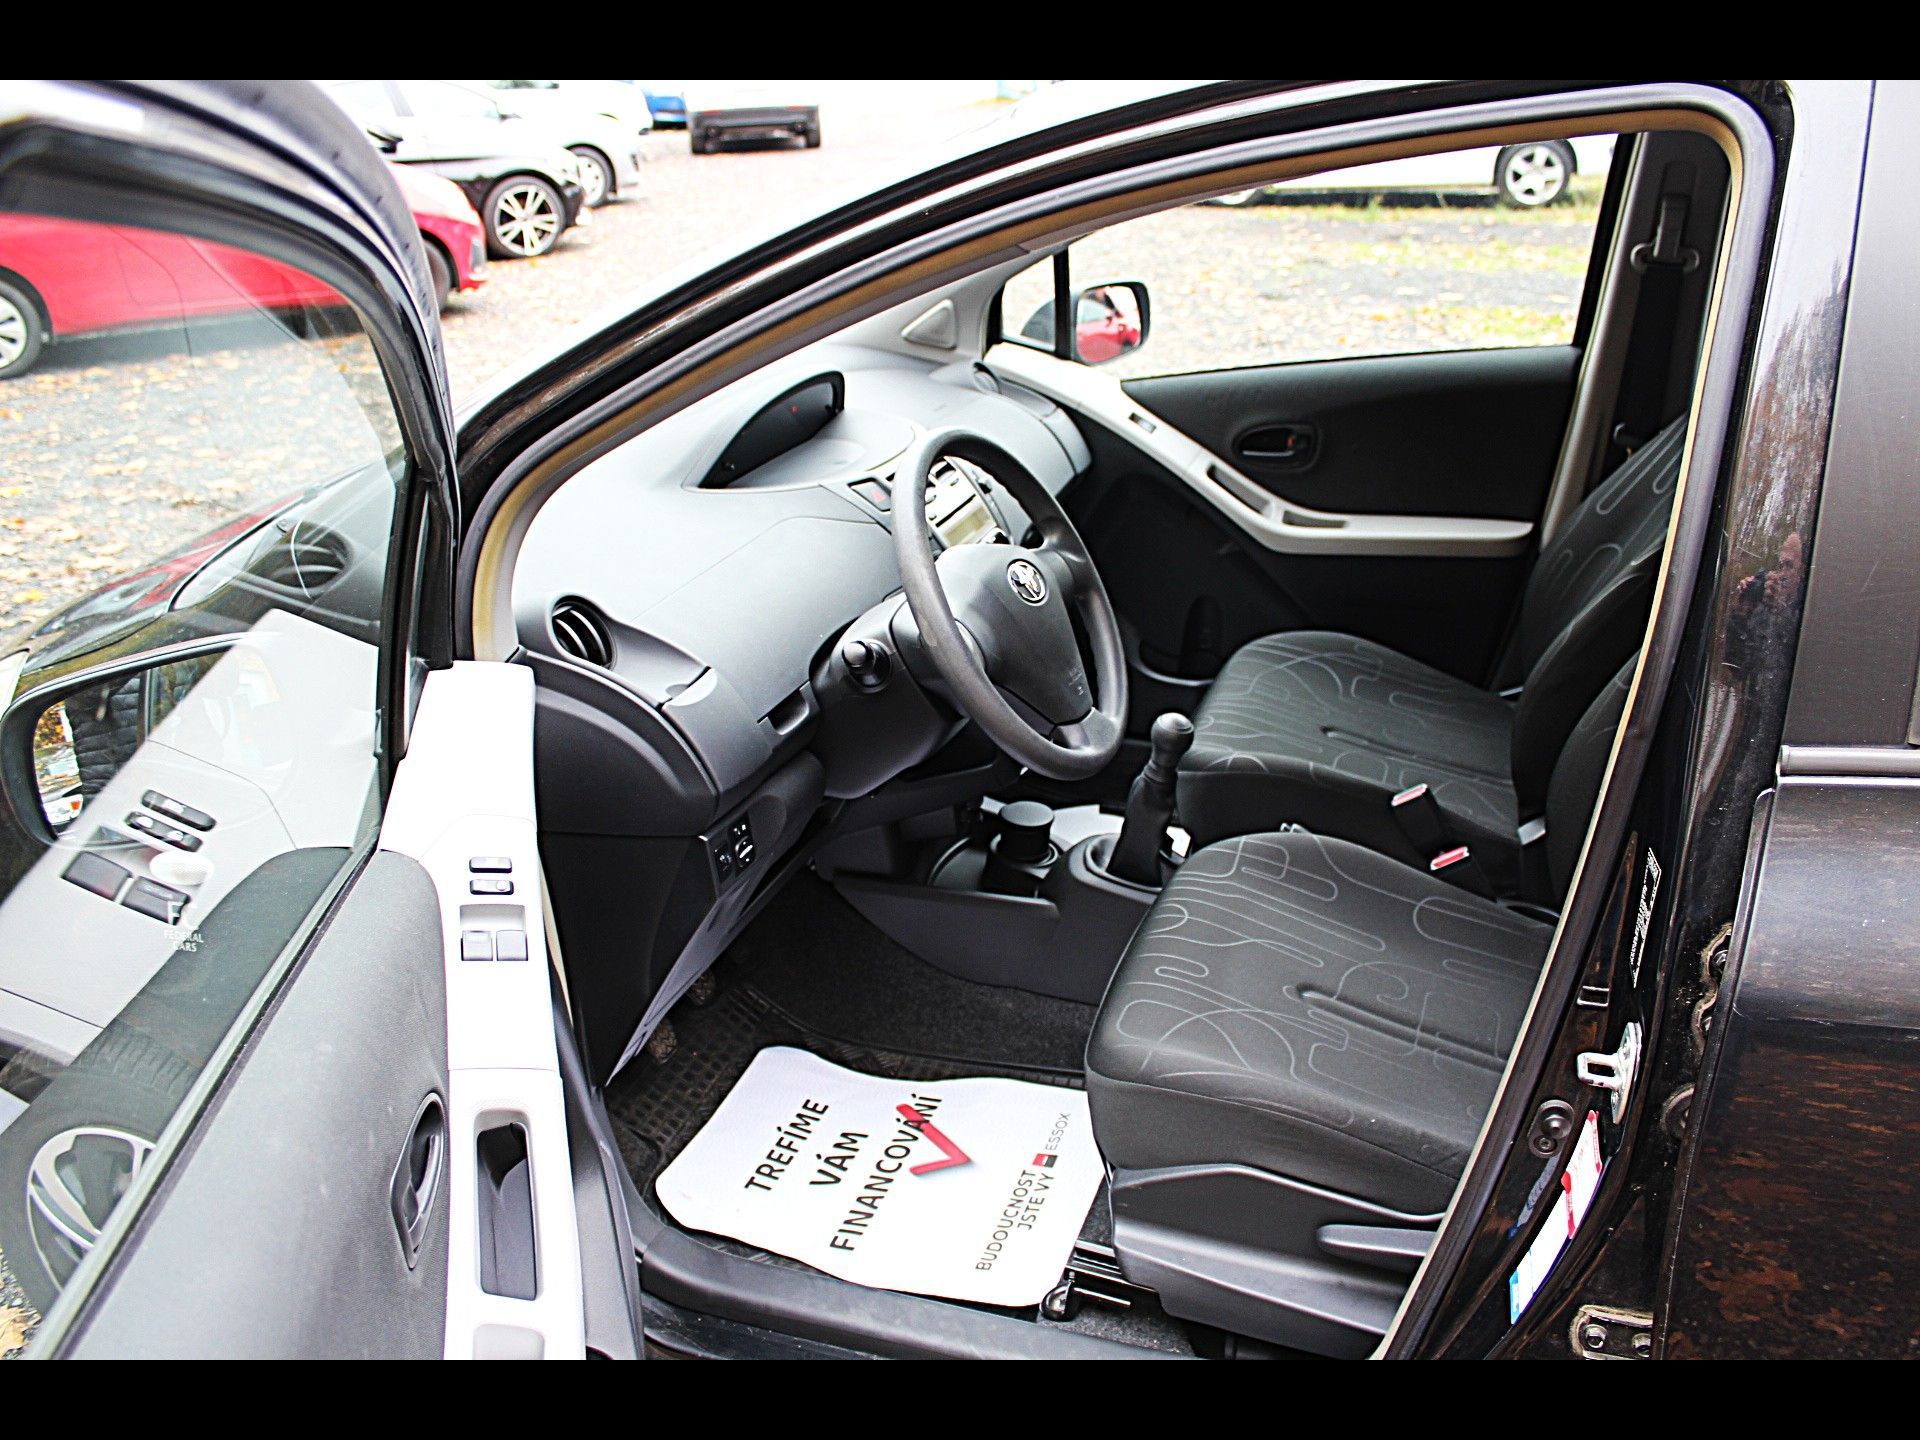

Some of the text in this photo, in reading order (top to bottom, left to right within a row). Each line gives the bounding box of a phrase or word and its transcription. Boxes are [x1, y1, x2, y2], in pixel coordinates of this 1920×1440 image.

[744, 1098, 829, 1191] TREFÍME
[809, 1132, 869, 1185] VÁM
[1045, 1112, 1071, 1151] ESSOX
[830, 1093, 942, 1251] FINANCOVÁNÍ
[1017, 1172, 1055, 1230] JSTE VY
[975, 1169, 1036, 1271] BUDOUCNOST
